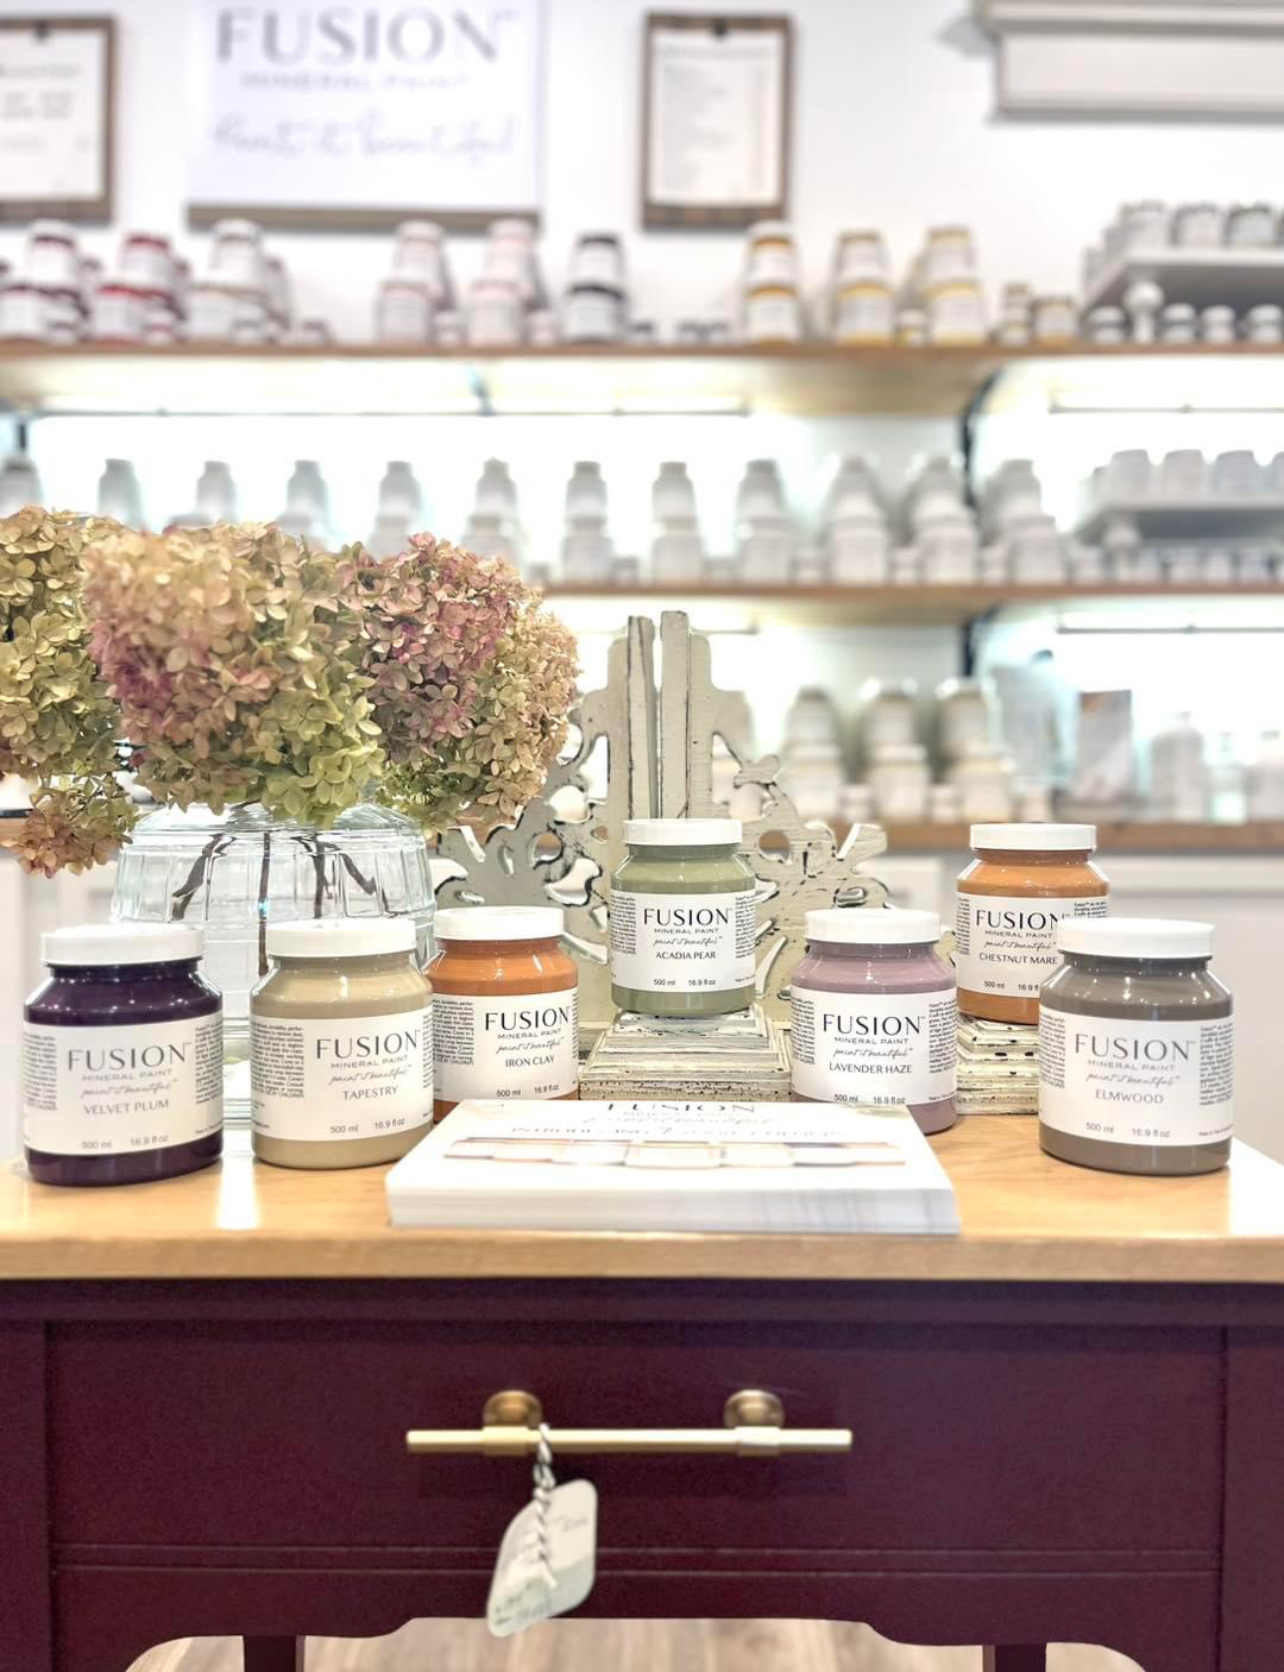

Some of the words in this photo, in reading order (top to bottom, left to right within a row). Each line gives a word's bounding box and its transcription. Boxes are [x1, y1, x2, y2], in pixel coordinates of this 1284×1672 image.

[216, 6, 497, 65] FUSION
[644, 908, 728, 926] FUSION
[976, 910, 1064, 930] FUSION
[979, 953, 1027, 963] CHESTNUT
[1030, 955, 1057, 965] MARE
[485, 1007, 569, 1031] FUSION
[823, 1013, 921, 1036] FUSION
[316, 1031, 418, 1059] FUSION
[834, 1037, 876, 1045] MINERAL
[1075, 1034, 1190, 1061] FUSION
[68, 1044, 186, 1071] FUSION
[331, 1060, 379, 1069] MINERAL
[382, 1055, 408, 1064] PAINT
[505, 1058, 531, 1068] IRON
[533, 1055, 555, 1065] CLAY
[829, 1063, 884, 1074] LAVENDER
[886, 1065, 912, 1073] HAZE
[1088, 1059, 1137, 1070] MINERAL
[1142, 1063, 1175, 1071] PAINT
[82, 1074, 134, 1082] MINERAL
[139, 1069, 172, 1078] PAINT
[343, 1085, 398, 1099] TAPESTRY
[496, 1089, 510, 1097] 500
[834, 1094, 847, 1102] 500
[1096, 1089, 1163, 1103] ELMWOOD
[84, 1103, 131, 1115] VELVET
[135, 1100, 169, 1112] PLUM
[348, 1124, 358, 1132] ml
[374, 1121, 390, 1129] 16.9
[1086, 1122, 1101, 1131] 500
[1104, 1124, 1114, 1133] ml
[82, 1141, 98, 1149] 500
